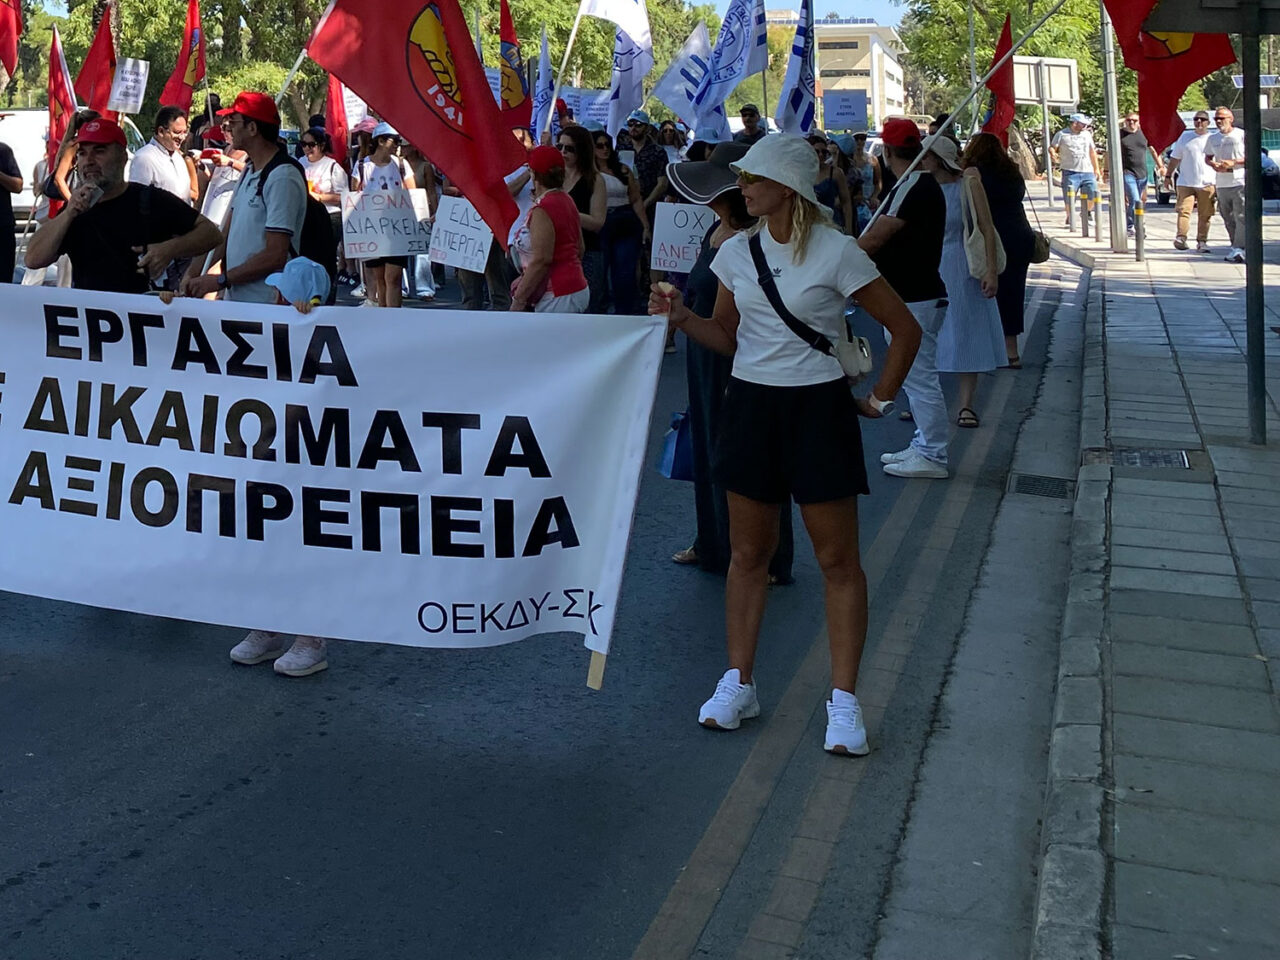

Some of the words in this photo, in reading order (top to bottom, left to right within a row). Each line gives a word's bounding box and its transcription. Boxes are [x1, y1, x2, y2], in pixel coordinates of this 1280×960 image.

[427, 84, 463, 126] 1941
[346, 241, 378, 254] ΠΕΟ
[431, 227, 486, 260] ΑΠΕΡΓΙΑ
[653, 256, 678, 269] ΠΕΟ
[42, 304, 359, 388] ΕΡΓΑΣΙΑ
[22, 376, 553, 479] ΔΙΚΑΙΩΜΑΤΑ
[8, 449, 581, 559] ΑΞΙΟΠΡΕΠΕΙΑ
